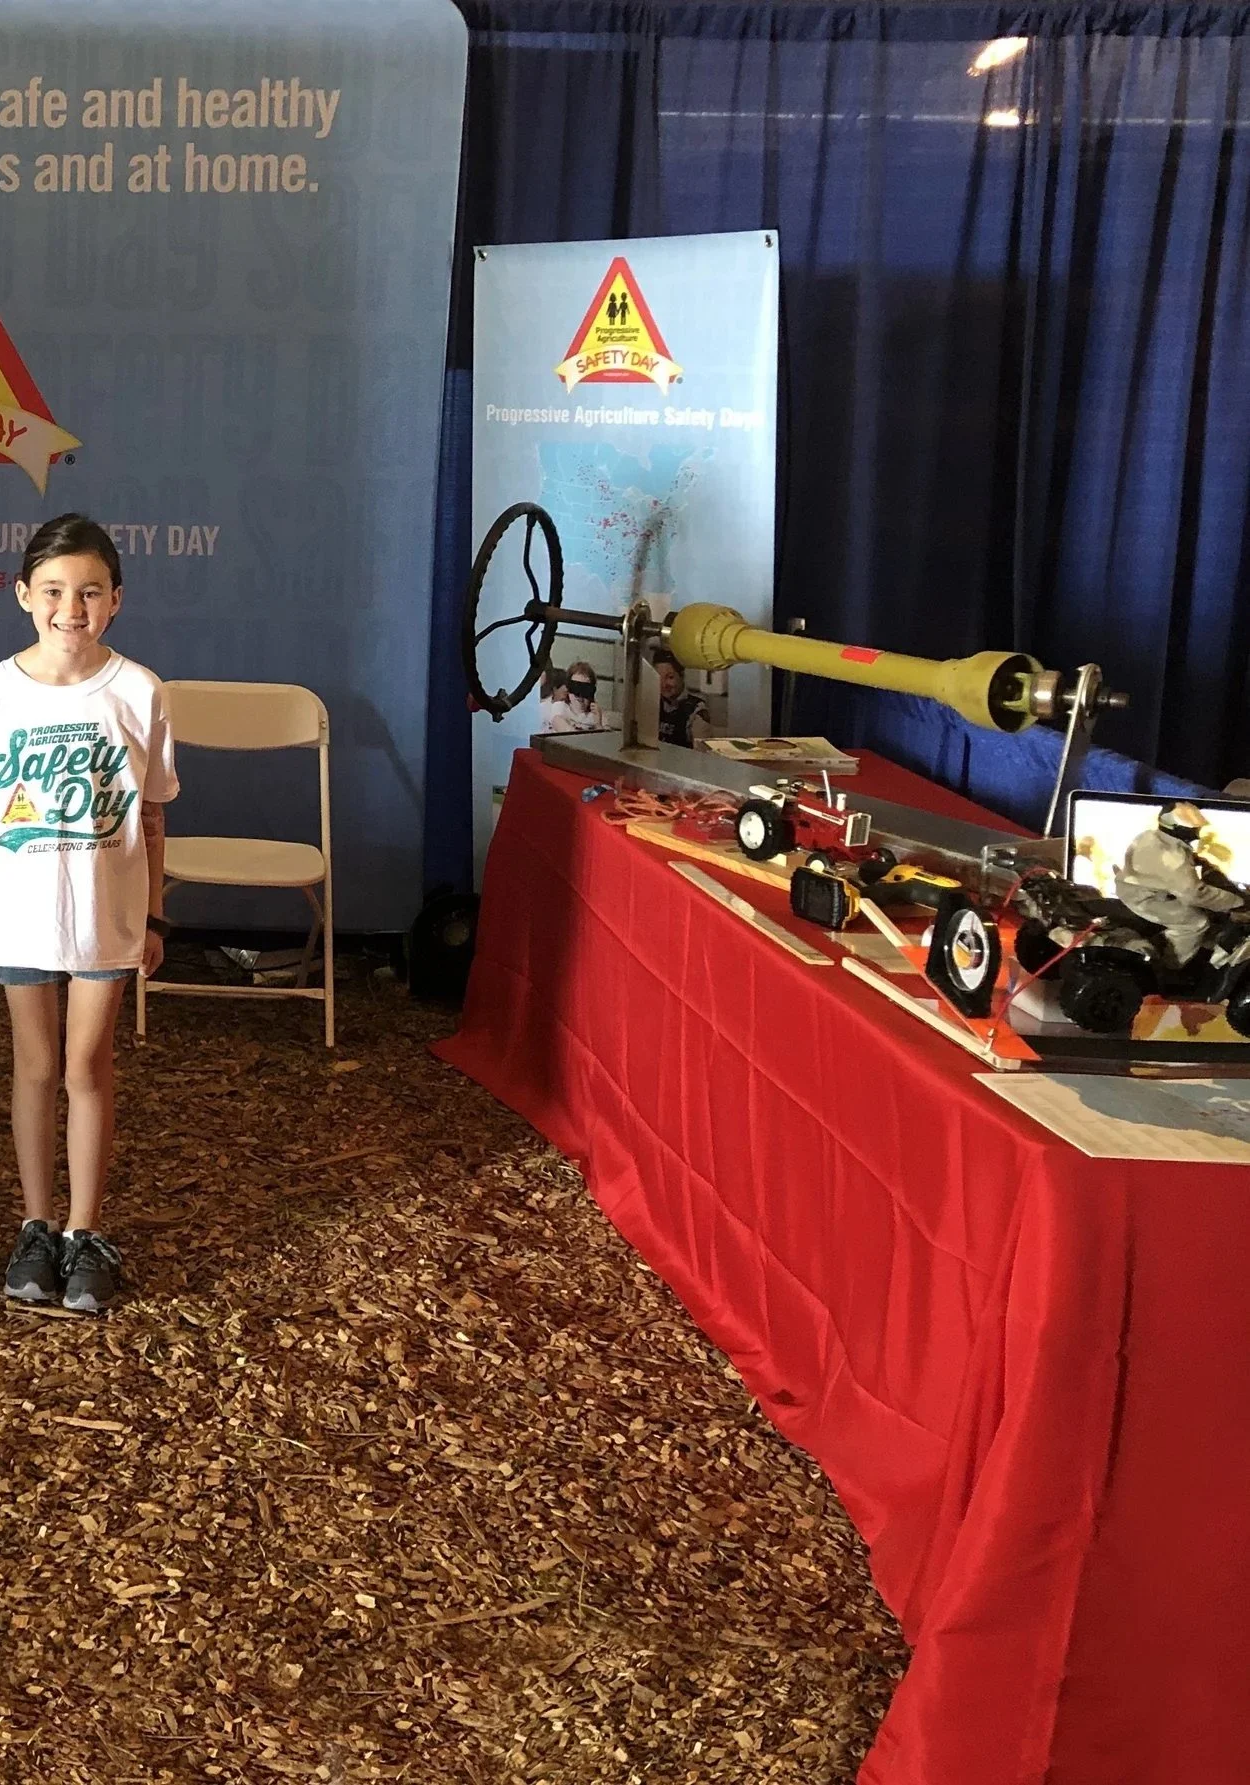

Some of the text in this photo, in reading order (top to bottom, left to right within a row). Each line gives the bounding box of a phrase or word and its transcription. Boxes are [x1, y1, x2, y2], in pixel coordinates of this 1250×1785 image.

[82, 77, 162, 128] and
[177, 76, 340, 139] healthy
[34, 142, 113, 193] and
[128, 144, 171, 193] at
[185, 142, 319, 193] home.
[595, 326, 640, 336] Progressive
[597, 335, 639, 344] Agriculture
[576, 349, 659, 374] SAFETY DAY
[486, 404, 570, 426] Progressive
[574, 405, 659, 427] Agriculture
[664, 406, 715, 430] Safety
[167, 525, 220, 556] DAY
[28, 732, 100, 747] AGRICULTURE
[30, 722, 100, 737] PROGRESSIVE
[44, 776, 138, 830] Day
[85, 841, 98, 851] 25
